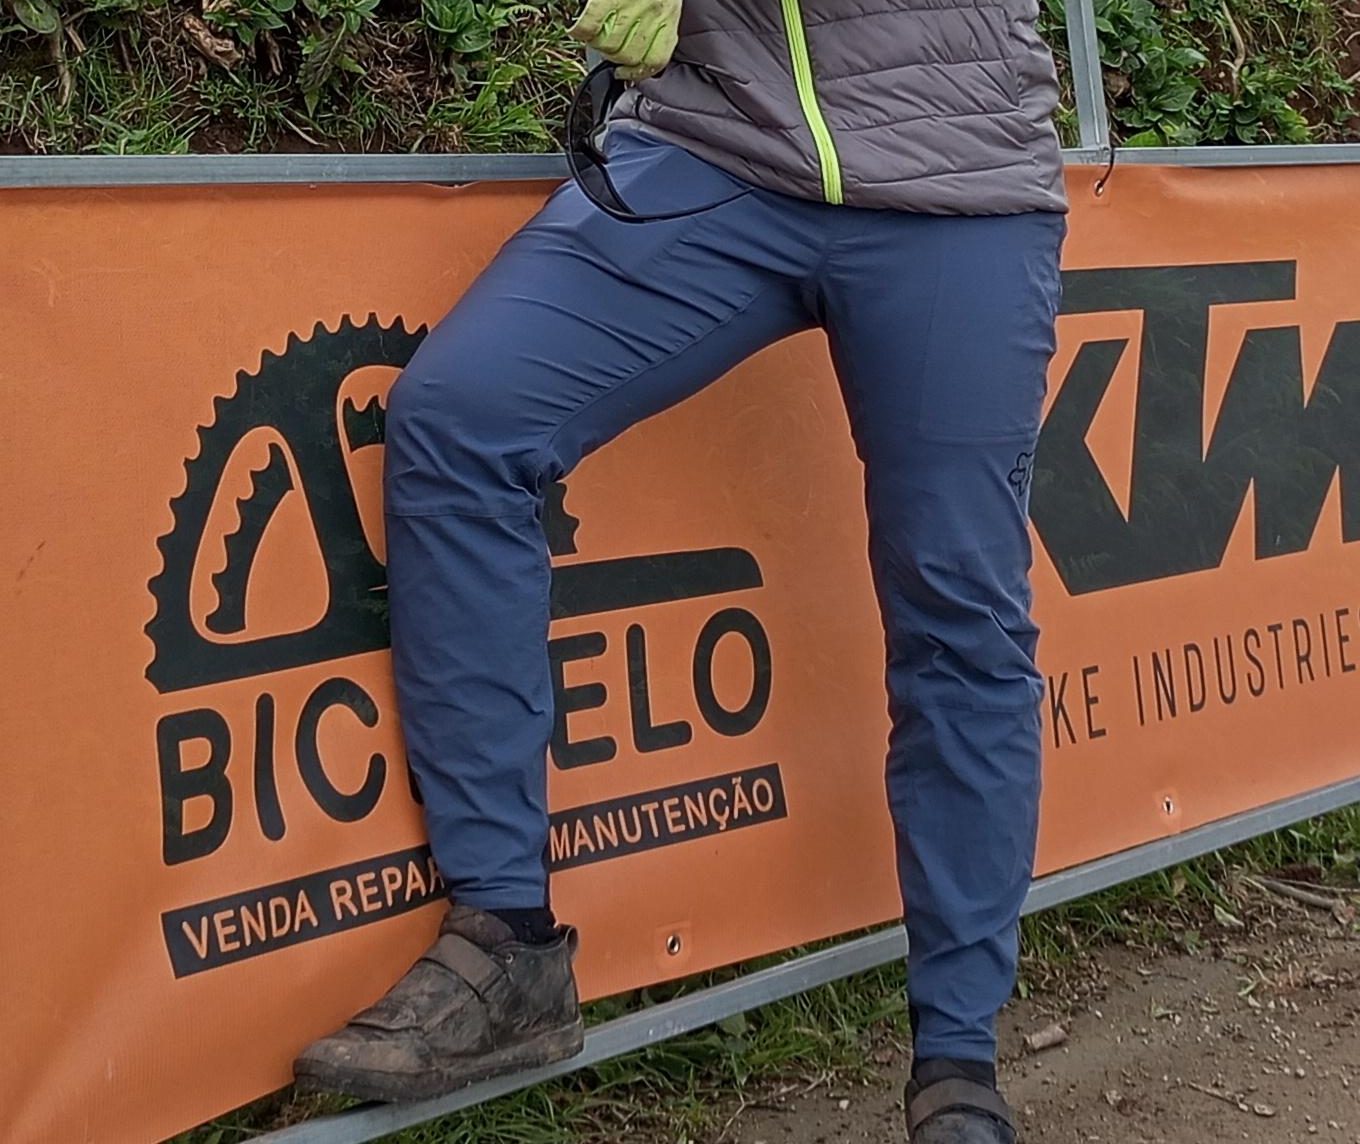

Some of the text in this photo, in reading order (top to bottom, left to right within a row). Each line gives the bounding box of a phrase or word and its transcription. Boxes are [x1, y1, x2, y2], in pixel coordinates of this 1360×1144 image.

[1048, 665, 1107, 749] KE
[181, 889, 319, 959] VENDA
[549, 776, 775, 862] MANUTENÇÃO
